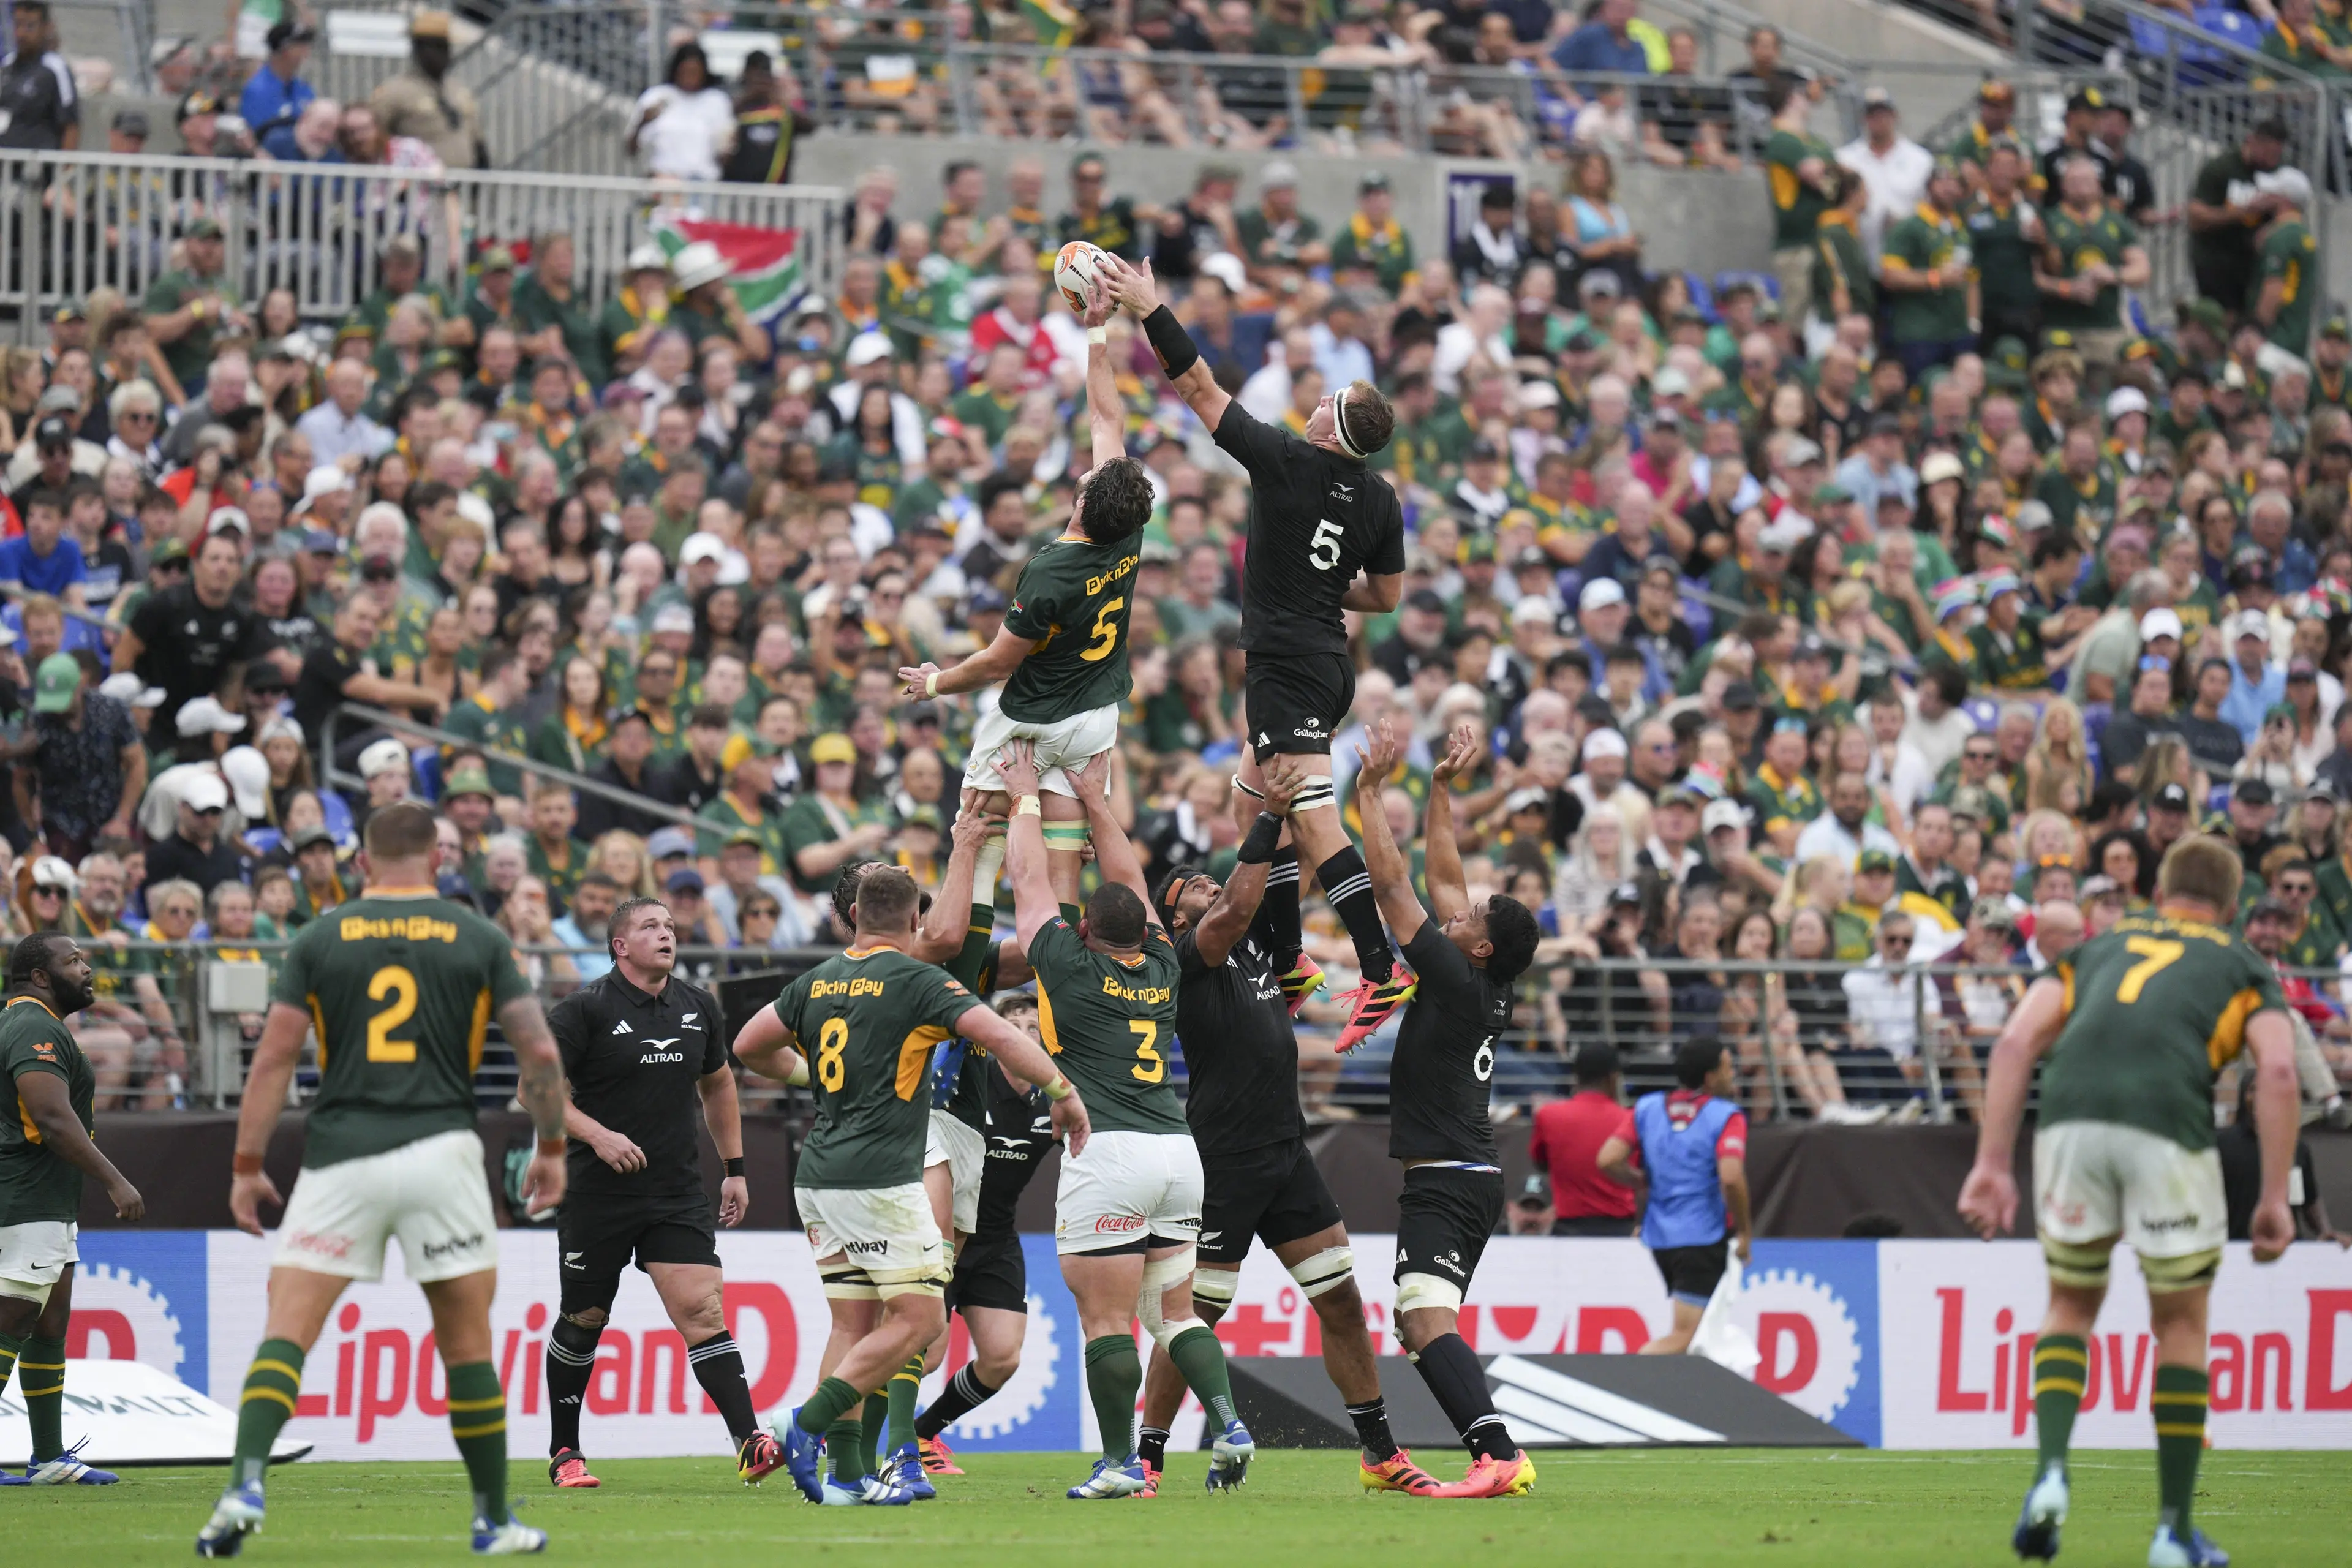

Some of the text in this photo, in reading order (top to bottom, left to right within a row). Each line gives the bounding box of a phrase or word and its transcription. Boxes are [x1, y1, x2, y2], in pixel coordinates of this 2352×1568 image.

[1329, 491, 1353, 502] ALTRAD
[1308, 519, 1344, 570] 5
[1079, 596, 1123, 661] 5
[1294, 728, 1328, 739] Gallagher
[2117, 935, 2185, 1003] 7
[367, 965, 418, 1063] 2
[640, 1053, 683, 1063] ALTRAD
[818, 1017, 848, 1093] 8
[1129, 1020, 1164, 1084] 3
[1473, 1035, 1494, 1082] 6
[986, 1149, 1028, 1161] ALTRAD
[1434, 1255, 1466, 1278] Gallagher
[701, 1281, 801, 1414] D
